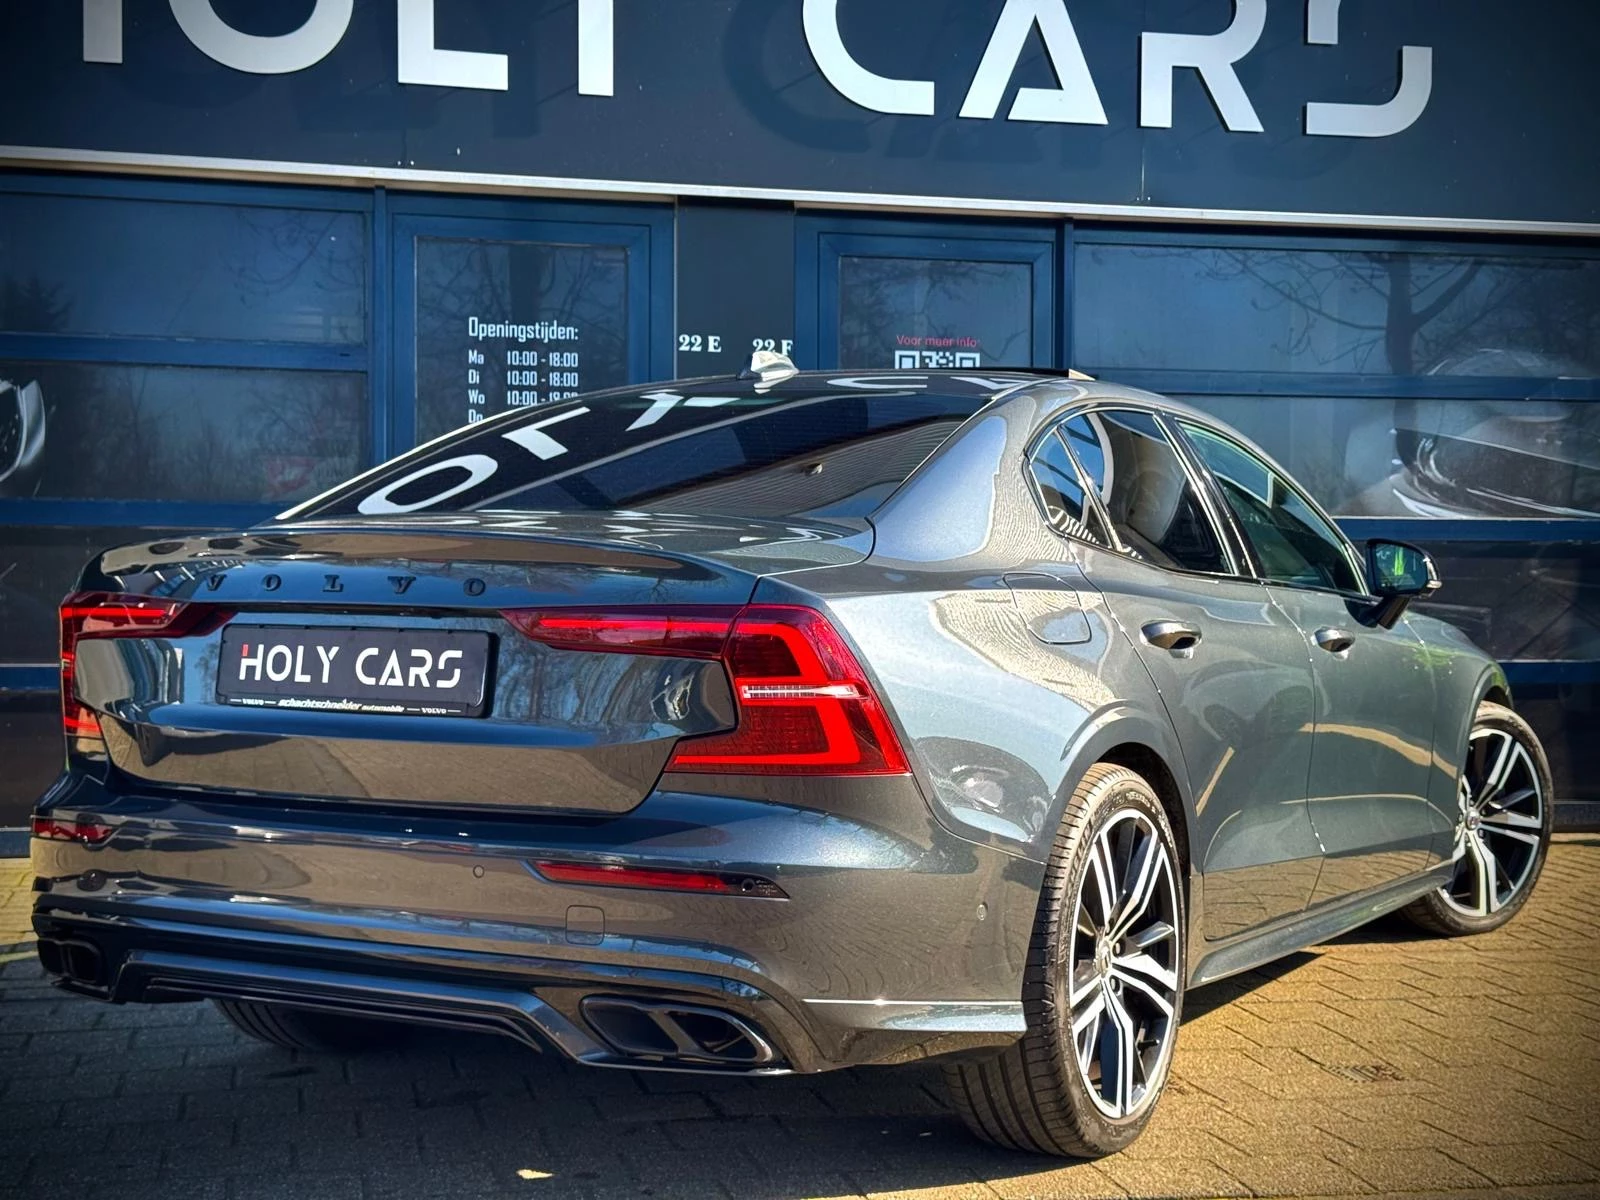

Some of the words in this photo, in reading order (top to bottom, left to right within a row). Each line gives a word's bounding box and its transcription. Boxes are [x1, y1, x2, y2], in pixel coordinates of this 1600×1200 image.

[468, 316, 579, 343] Openingstijden:
[678, 334, 702, 352] 22
[707, 335, 722, 353] E
[752, 338, 776, 352] 22
[896, 335, 922, 346] Voor
[468, 350, 484, 364] Ma
[507, 351, 538, 366] 10:00
[549, 352, 579, 367] 18:00
[468, 369, 480, 384] Di
[507, 371, 538, 386] 10:00
[549, 372, 579, 387] 18:00
[468, 389, 485, 405] Wo
[507, 391, 538, 406] 10:00
[206, 574, 487, 597] VOLVO
[238, 643, 340, 684] HOLY
[355, 647, 463, 689] CARS
